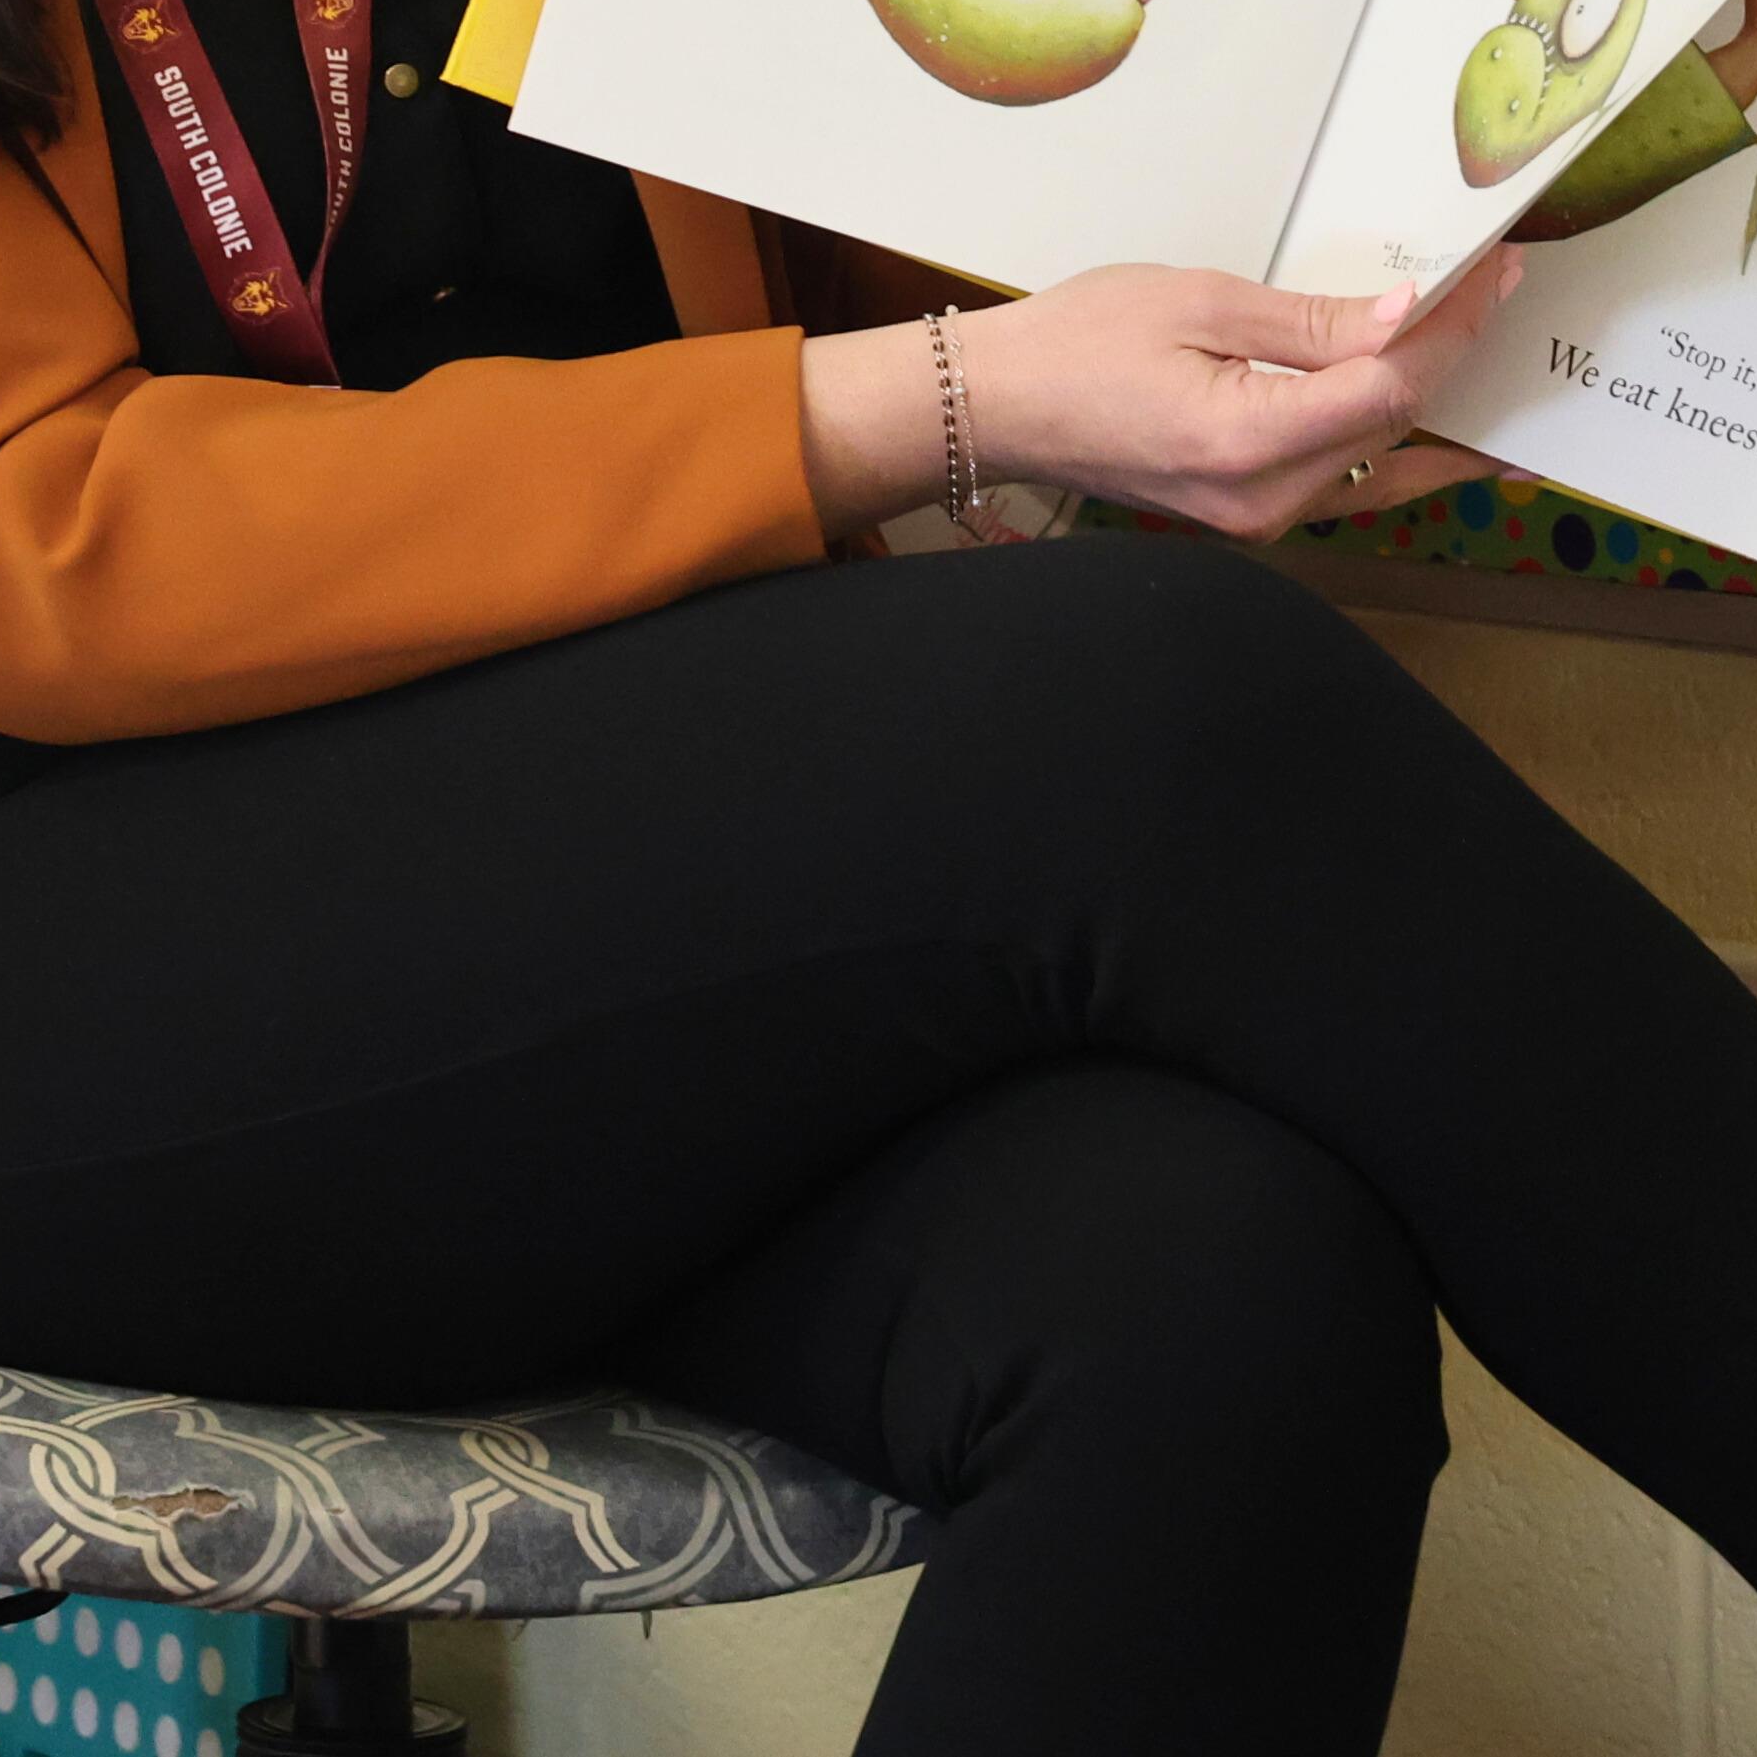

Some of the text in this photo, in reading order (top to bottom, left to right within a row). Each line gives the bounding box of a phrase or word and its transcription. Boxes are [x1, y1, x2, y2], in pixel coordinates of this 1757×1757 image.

[325, 46, 354, 153] COLONIE
[153, 65, 254, 260] SOUTH COLONIE
[1546, 337, 1601, 388] We
[1608, 374, 1661, 412] eat
[1659, 325, 1727, 381] “Stop
[1732, 357, 1757, 392] it,
